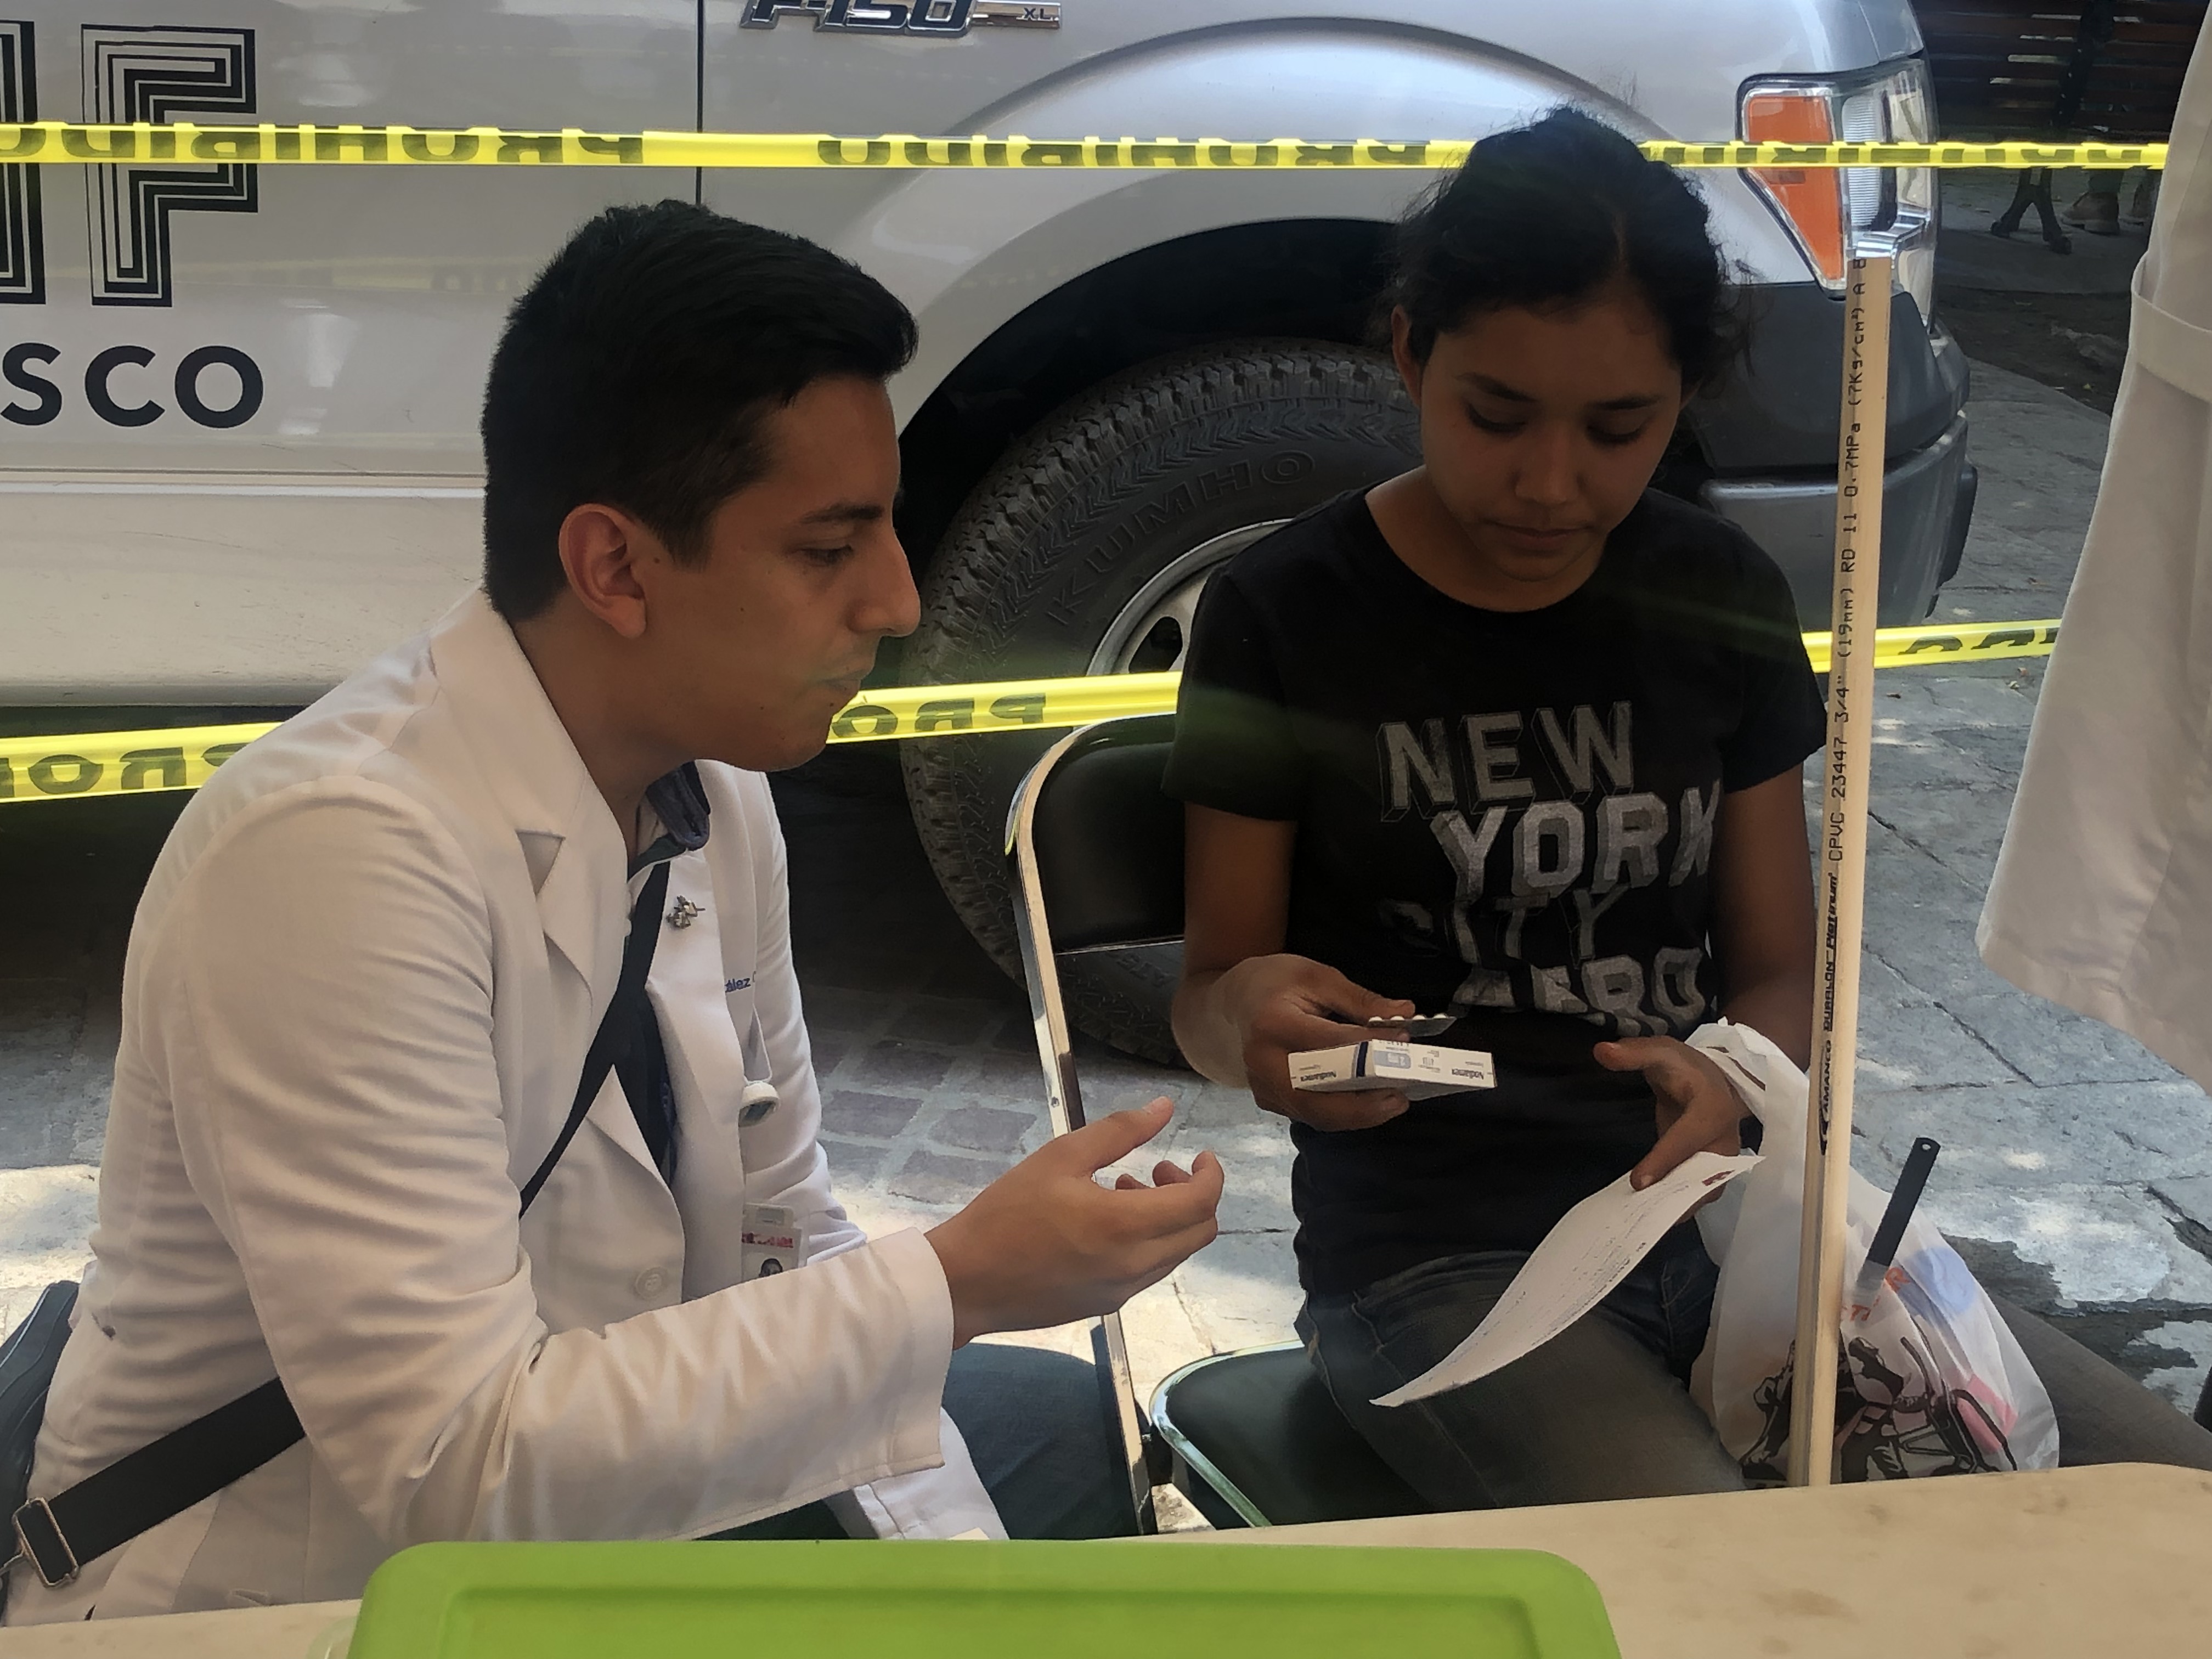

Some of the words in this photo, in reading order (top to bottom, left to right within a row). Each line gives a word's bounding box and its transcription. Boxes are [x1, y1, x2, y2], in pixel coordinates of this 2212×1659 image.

[1023, 7, 1053, 21] XL
[1853, 282, 1866, 294] A
[0, 342, 264, 428] SCO
[1843, 422, 1860, 497] 0.7MPa
[1045, 450, 1315, 627] KUMHO
[1841, 548, 1855, 572] RD
[1838, 587, 1854, 658] (19mm)
[1833, 674, 1849, 723] 3/4"
[1375, 701, 1634, 822] NEW
[1831, 736, 1847, 798] 23447
[1430, 779, 1722, 904] YORK
[1828, 811, 1845, 861] CPVC
[1826, 873, 1837, 950] Platinum
[1822, 960, 1835, 1031] DURALON
